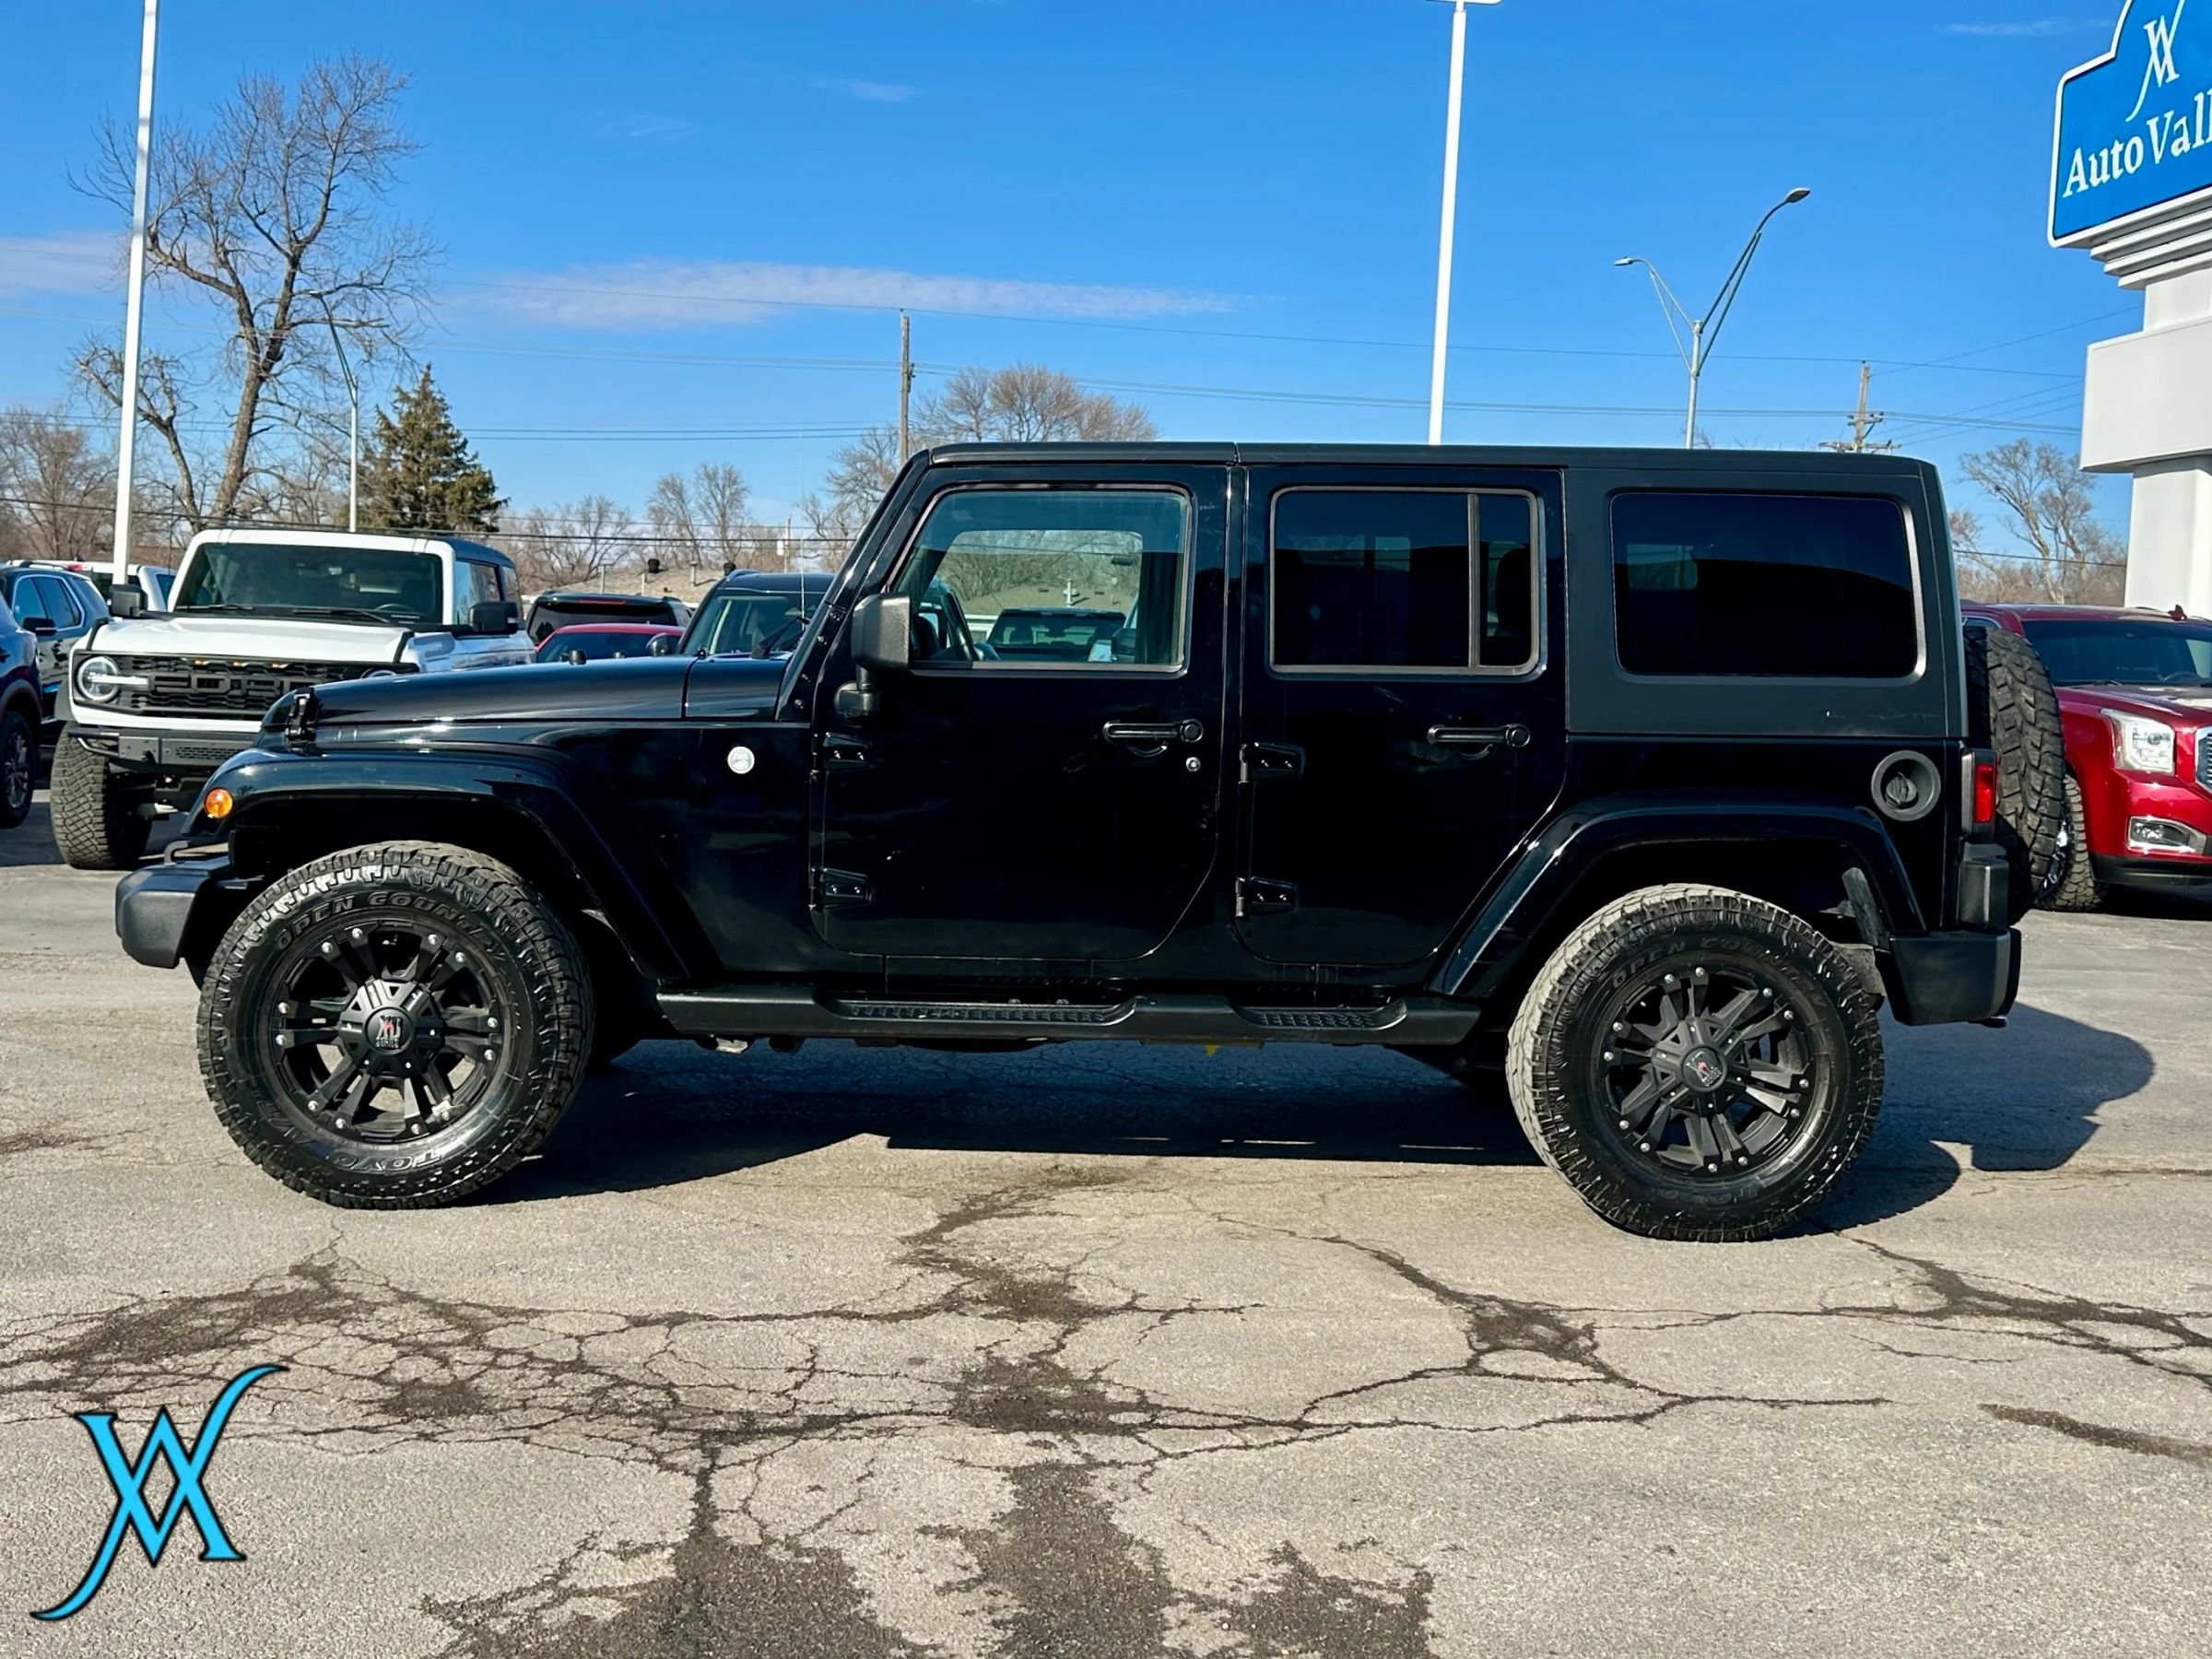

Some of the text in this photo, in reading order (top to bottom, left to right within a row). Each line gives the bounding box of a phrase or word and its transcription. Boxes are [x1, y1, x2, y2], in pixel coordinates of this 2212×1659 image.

[275, 890, 507, 962] OPEN COUNTRY
[328, 1148, 442, 1174] TOYO
